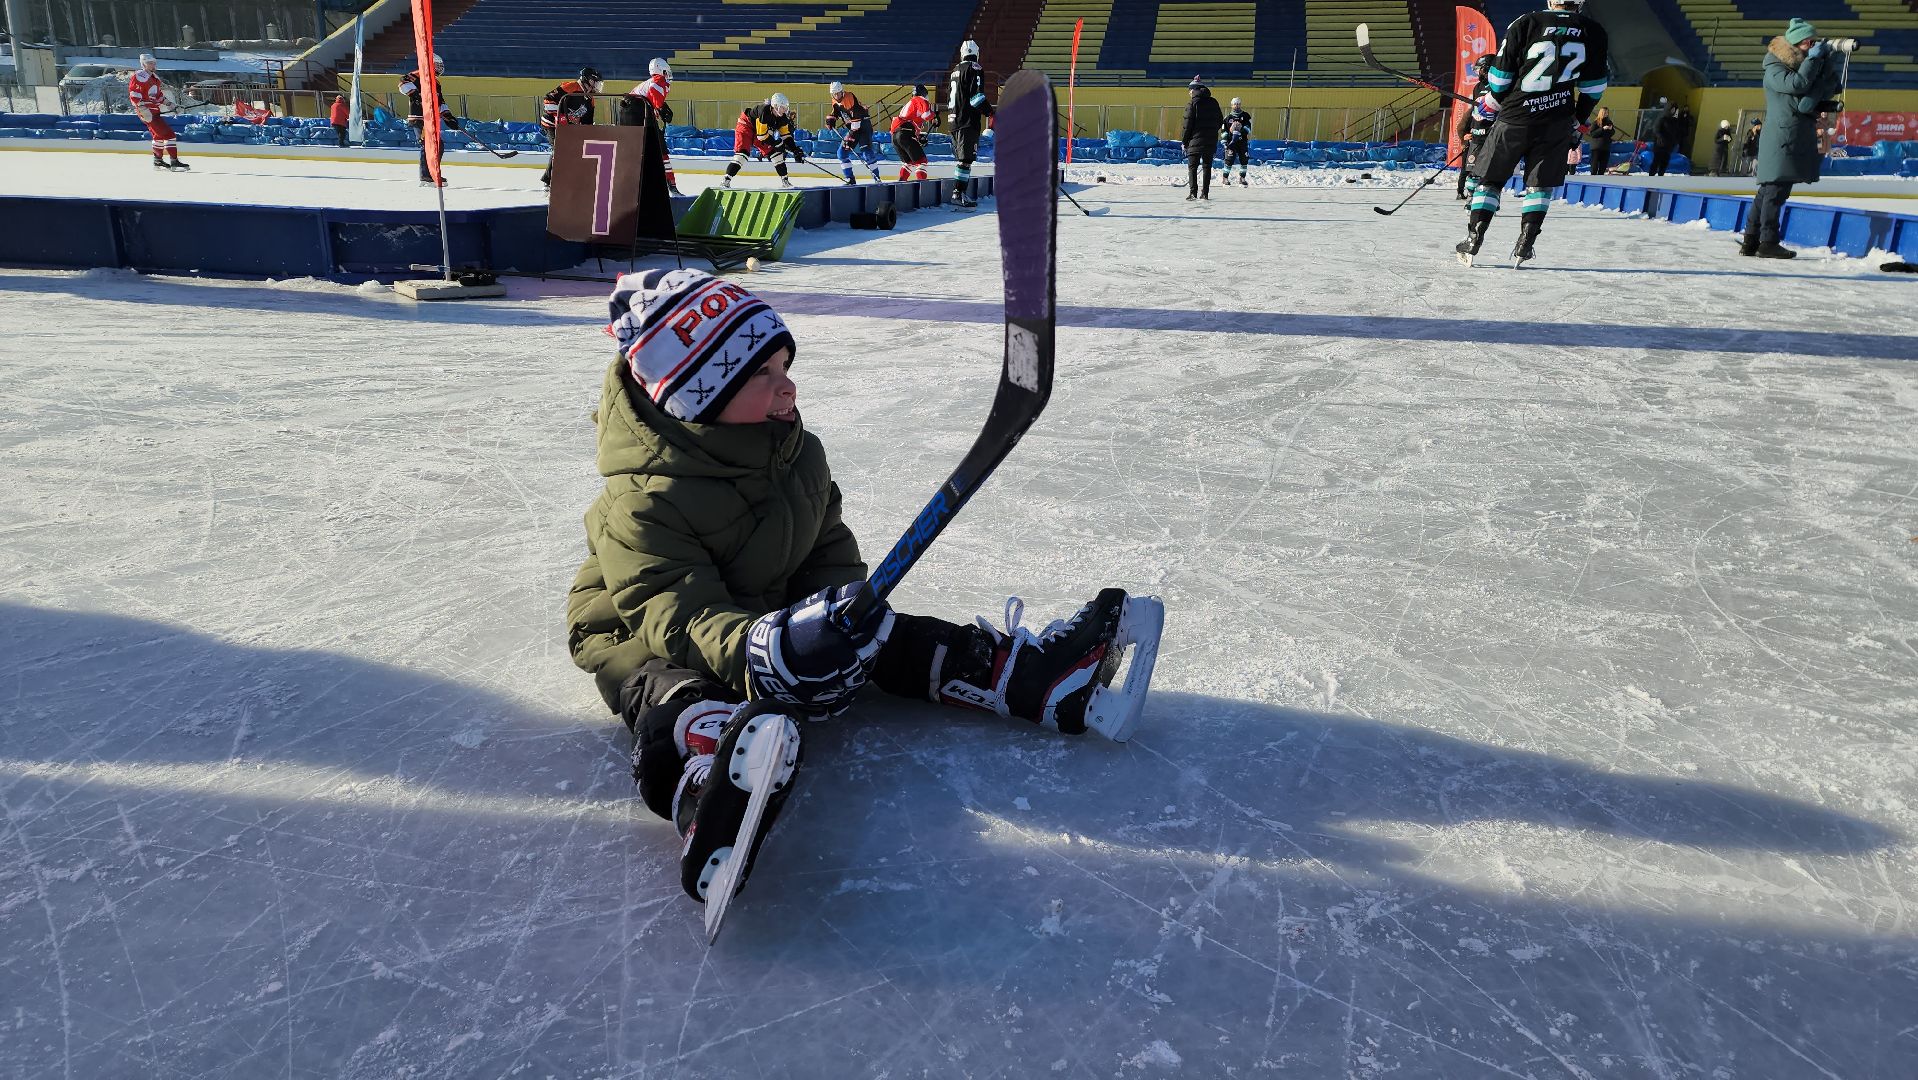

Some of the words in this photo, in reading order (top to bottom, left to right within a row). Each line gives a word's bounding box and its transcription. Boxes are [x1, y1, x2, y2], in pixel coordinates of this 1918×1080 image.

[1521, 41, 1586, 92] 22
[1522, 90, 1571, 107] ATRIBUTIKA
[1530, 105, 1537, 113] &
[1538, 99, 1560, 111] CLUB
[869, 491, 950, 598] FISCHER
